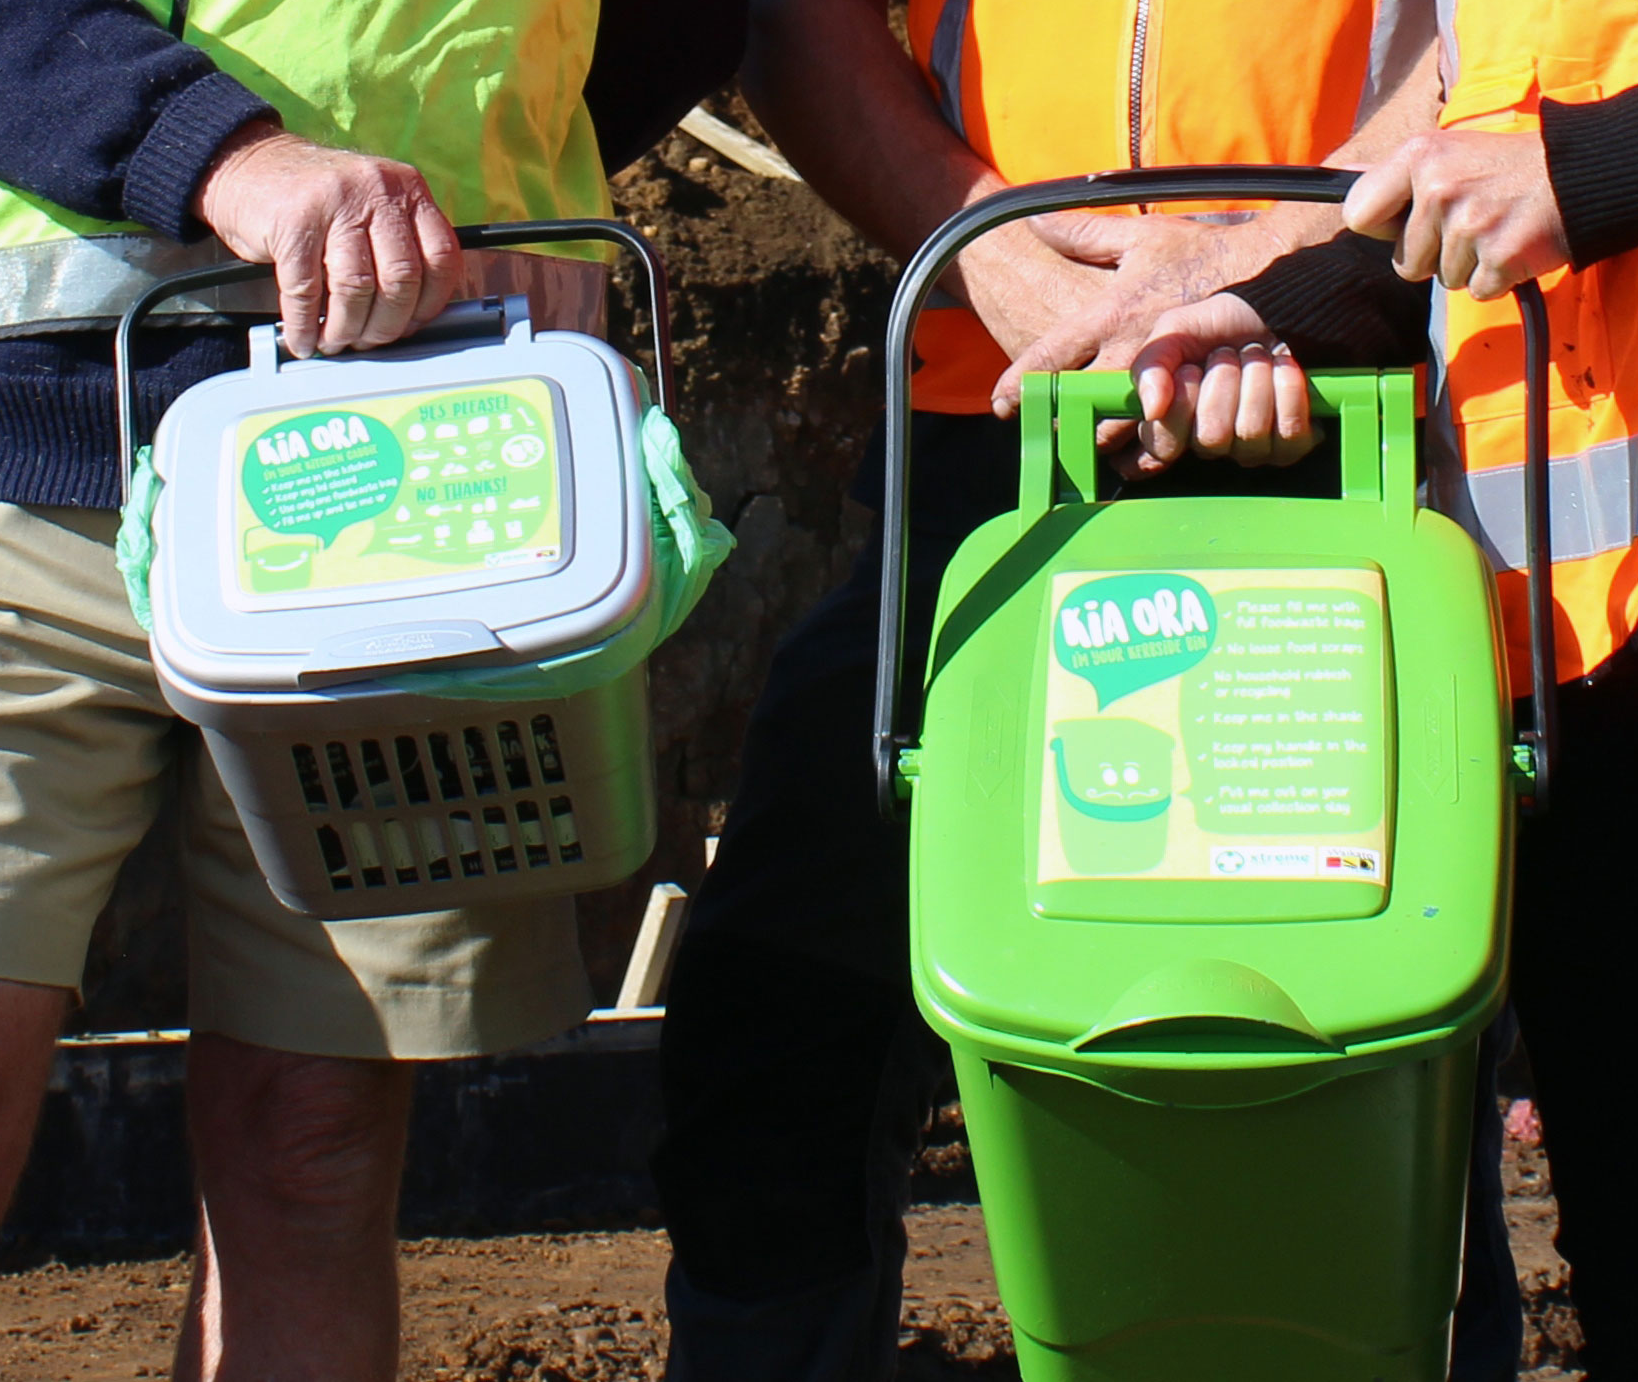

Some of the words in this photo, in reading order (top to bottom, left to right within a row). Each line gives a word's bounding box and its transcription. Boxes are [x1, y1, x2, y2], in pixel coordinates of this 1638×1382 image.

[419, 404, 446, 422] YES
[453, 395, 508, 418] PLEASE!
[310, 416, 371, 451] ORA
[271, 480, 294, 492] Keep
[295, 476, 311, 486] me
[312, 473, 323, 482] in
[323, 469, 341, 479] the
[341, 460, 378, 475] kitchen
[378, 477, 398, 488] bag
[274, 491, 298, 503] Keep
[300, 487, 315, 497] my
[315, 482, 328, 492] lid
[329, 474, 357, 489] closed
[416, 487, 437, 502] NO
[444, 476, 508, 501] THANKS!
[1131, 588, 1210, 638] ORA
[1237, 601, 1282, 614] Please
[1286, 601, 1303, 614] fill
[1306, 603, 1328, 614] me
[1331, 601, 1361, 615] with
[1236, 617, 1256, 629] full
[1261, 616, 1330, 629] foodwaste
[1334, 616, 1366, 631] bags
[1090, 647, 1125, 666] YOUR
[1127, 638, 1183, 660] KERBSIDE
[1185, 635, 1208, 652] BIN
[1227, 643, 1245, 656] No
[1249, 642, 1282, 655] loose
[1286, 641, 1317, 655] food
[1322, 644, 1365, 657] scraps
[1214, 670, 1232, 683] No
[1236, 669, 1301, 682] household
[1303, 668, 1352, 682] rubbish
[1215, 689, 1229, 699] or
[1233, 685, 1291, 701] recycling
[1213, 712, 1248, 726] Keep
[1251, 713, 1274, 725] me
[1277, 713, 1290, 724] in
[1294, 710, 1319, 723] the
[1323, 710, 1364, 724] shade
[1213, 741, 1248, 756] Keep
[1251, 743, 1273, 757] my
[1275, 739, 1323, 754] handle
[1327, 741, 1340, 753] in
[1344, 739, 1368, 754] the
[1213, 755, 1259, 770] locked
[1261, 755, 1314, 771] position
[1219, 785, 1245, 800] Put
[1247, 788, 1270, 799] me
[1274, 785, 1297, 799] out
[1300, 788, 1319, 799] on
[1322, 788, 1351, 801] your
[1219, 802, 1253, 816] usual
[1257, 801, 1322, 815] collection
[1324, 801, 1352, 817] day
